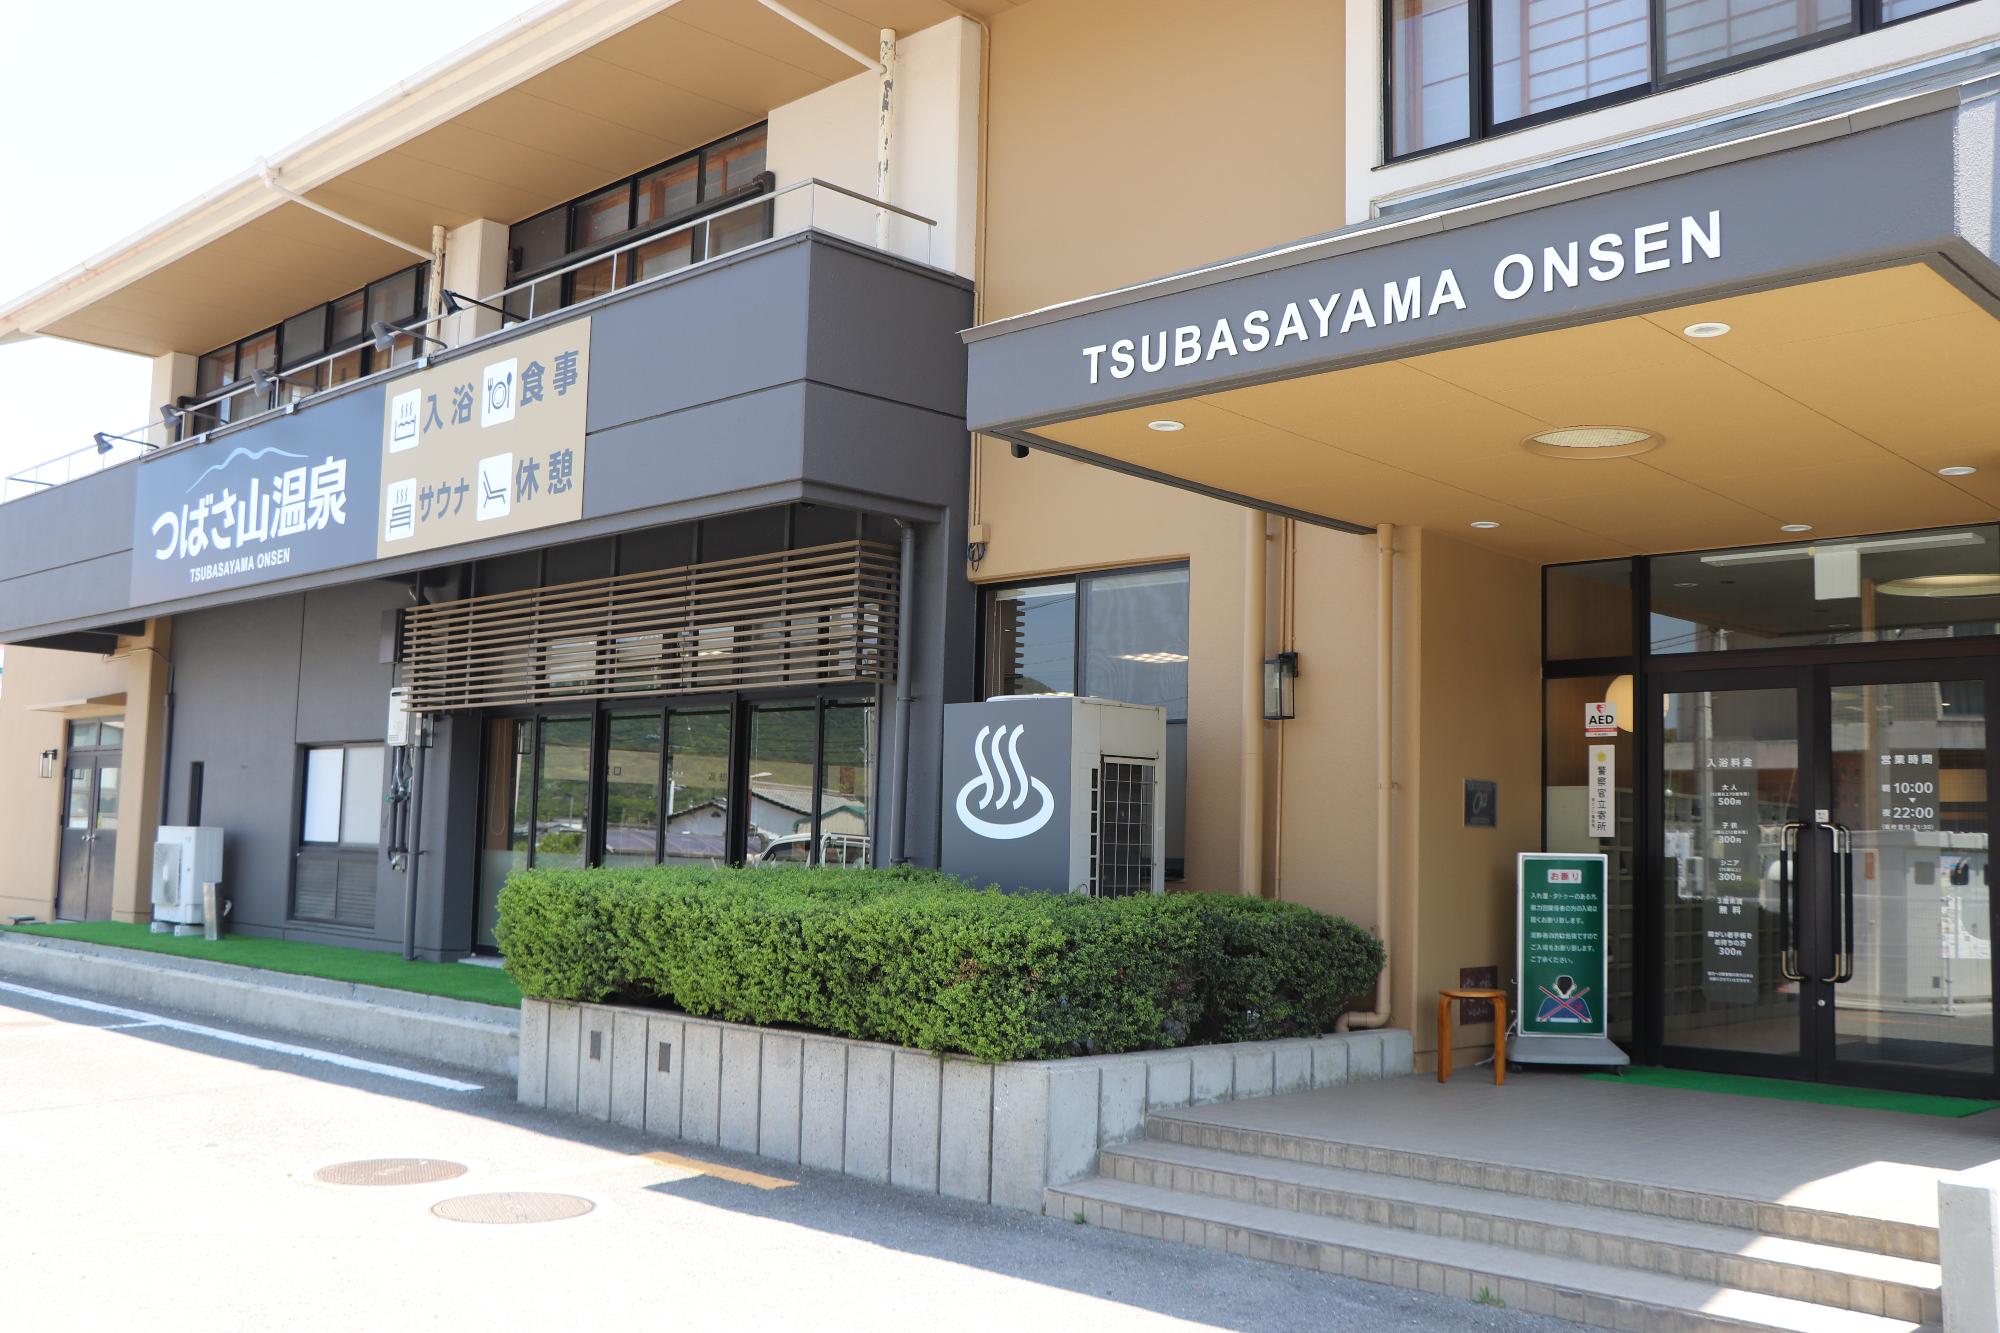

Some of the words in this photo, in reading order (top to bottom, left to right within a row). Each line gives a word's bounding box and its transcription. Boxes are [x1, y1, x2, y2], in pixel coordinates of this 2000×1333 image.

[1083, 269, 1467, 385] TSUBASAYAMA
[1492, 210, 1723, 300] ONSEN
[520, 350, 579, 407] 食事
[423, 382, 474, 434] 入浴
[515, 448, 573, 503] 休憩
[152, 456, 347, 560] つばさ山温泉
[419, 477, 470, 522] サウナ
[190, 555, 254, 583] TSUBASAYAMA
[257, 547, 290, 569] ONSEN
[1589, 715, 1614, 725] AED
[1706, 757, 1753, 767] 入浴料金
[1880, 754, 1933, 765] 営業時間
[1718, 797, 1742, 806] 500円
